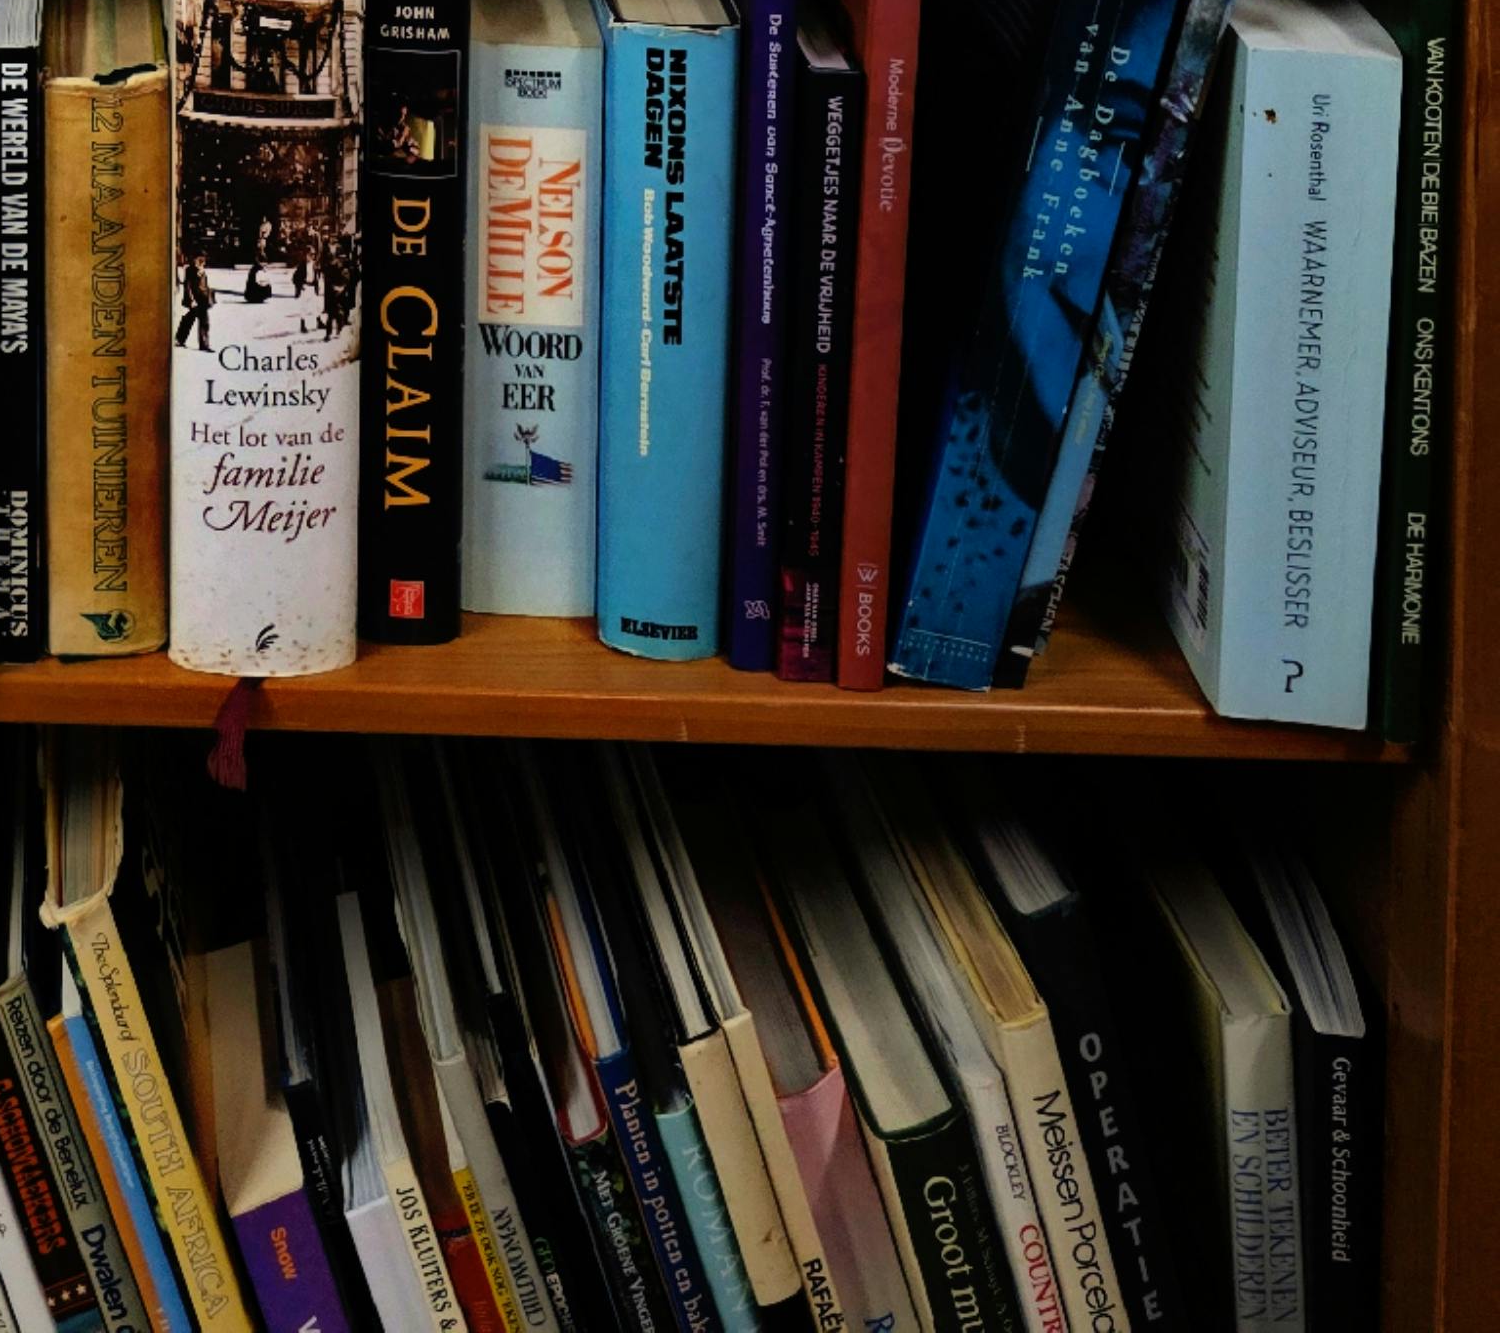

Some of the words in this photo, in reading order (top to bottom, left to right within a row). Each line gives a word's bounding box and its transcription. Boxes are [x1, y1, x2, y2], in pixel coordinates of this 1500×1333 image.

[379, 24, 452, 41] GRISHAM
[393, 4, 436, 20] JOHN
[1, 62, 29, 92] DE
[643, 46, 666, 169] DAGEN
[1311, 94, 1331, 118] Uri
[1, 97, 29, 186] WERELD
[665, 47, 688, 185] NIXONS
[1308, 121, 1330, 202] Rosenthal
[1, 192, 28, 236] VAN
[389, 196, 432, 257] DE
[484, 133, 534, 316] DEMILLE
[536, 158, 581, 301] NELSON
[1, 242, 28, 271] DE
[662, 191, 686, 346] LAATSTE
[0, 277, 29, 354] MAYA'S
[1296, 220, 1328, 376] WAARNEMER,
[217, 343, 320, 375] Charles
[477, 323, 584, 363] WOORD
[514, 365, 546, 381] VAN
[203, 378, 331, 416] Lewinsky
[378, 284, 440, 512] CLAIM
[500, 381, 557, 413] EER
[1408, 363, 1433, 456] KENTONS
[208, 451, 327, 498] familie
[1286, 383, 1321, 502] ADVISEUR,
[202, 499, 338, 542] Meijer
[10, 490, 29, 637] DOMINICUS
[1284, 509, 1314, 629] BESLISSER
[1400, 542, 1426, 645] HARMONIE
[856, 592, 872, 656] BOOKS
[1330, 1056, 1353, 1129] Gevaar
[995, 1123, 1026, 1201] BLOCKLEY
[1033, 1089, 1085, 1222] Meissen
[1332, 1129, 1351, 1143] &
[922, 1174, 974, 1280] Groot
[1331, 1146, 1353, 1262] Schoonheid
[269, 1226, 298, 1281] Snow
